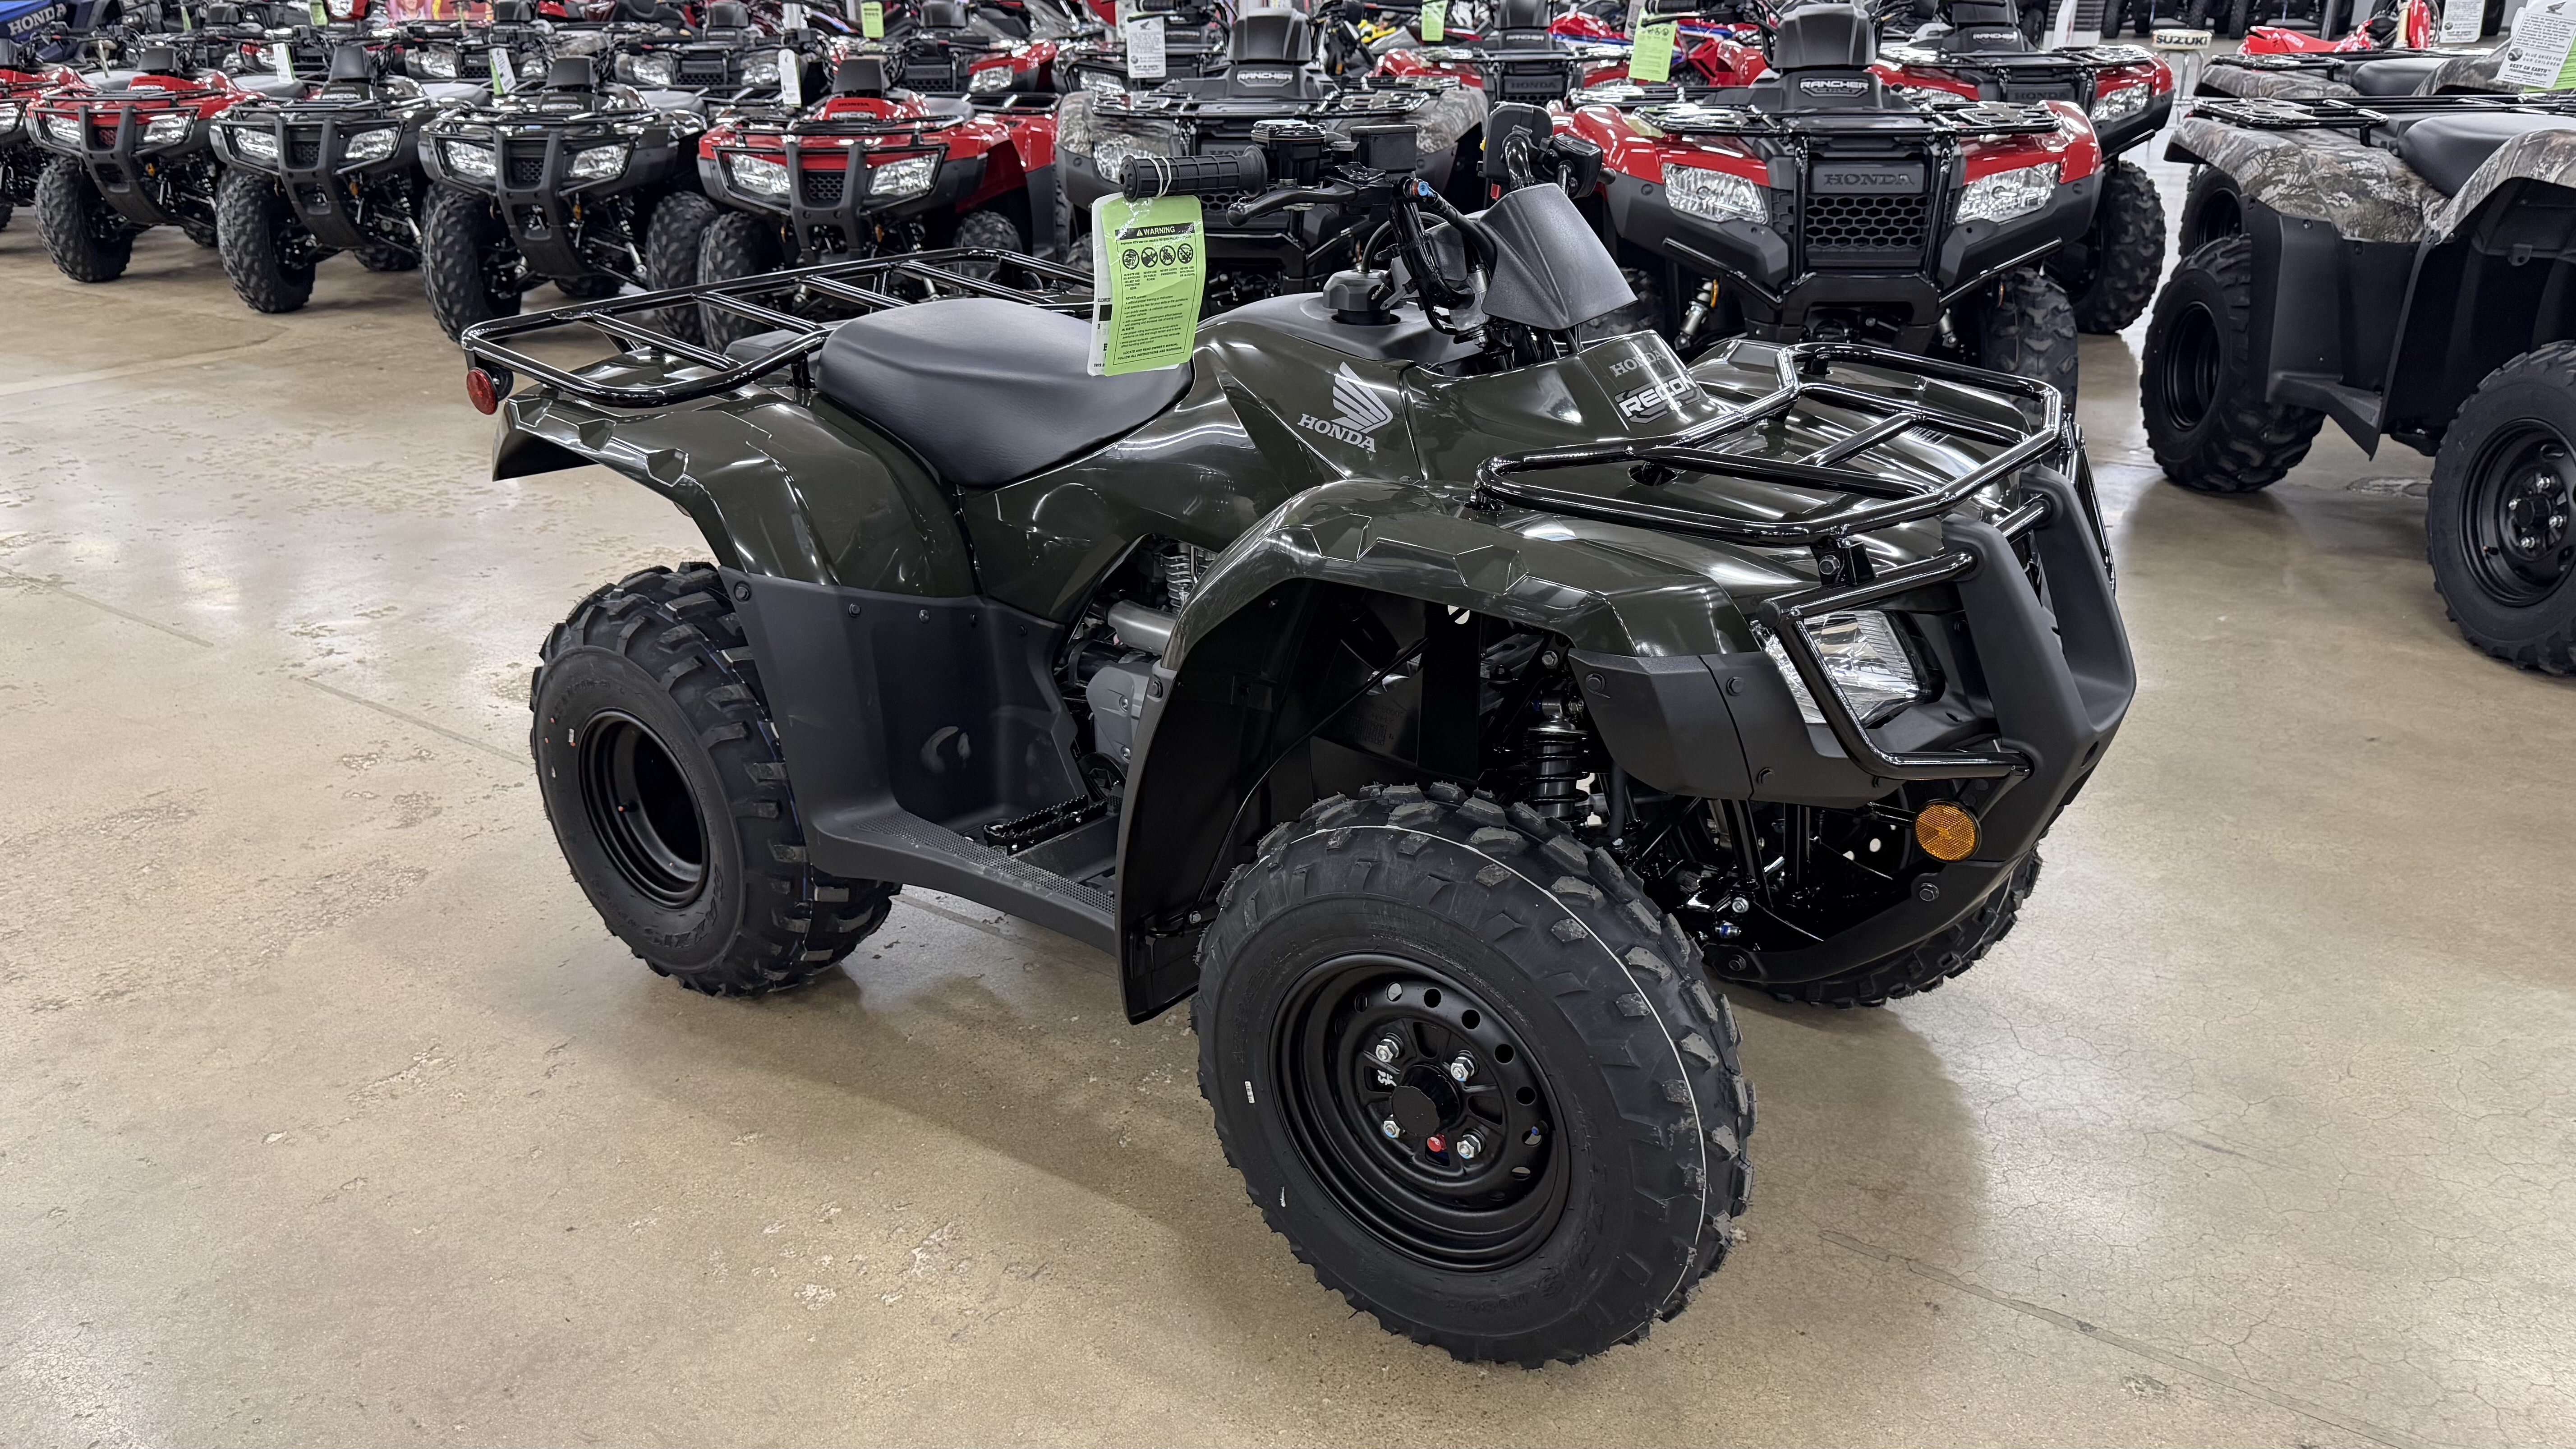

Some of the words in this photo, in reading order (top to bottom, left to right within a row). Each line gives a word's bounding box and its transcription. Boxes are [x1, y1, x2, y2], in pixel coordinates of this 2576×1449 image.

[7, 3, 67, 36] HONDA
[2156, 35, 2208, 45] SUZUKI
[1800, 81, 1869, 89] RANCHER
[829, 111, 877, 120] RECON
[1824, 174, 1915, 185] HONDA
[1144, 226, 1175, 235] WARNING
[1609, 350, 1668, 377] HONDA
[1619, 375, 1697, 417] RECON
[1297, 414, 1376, 452] HONDA
